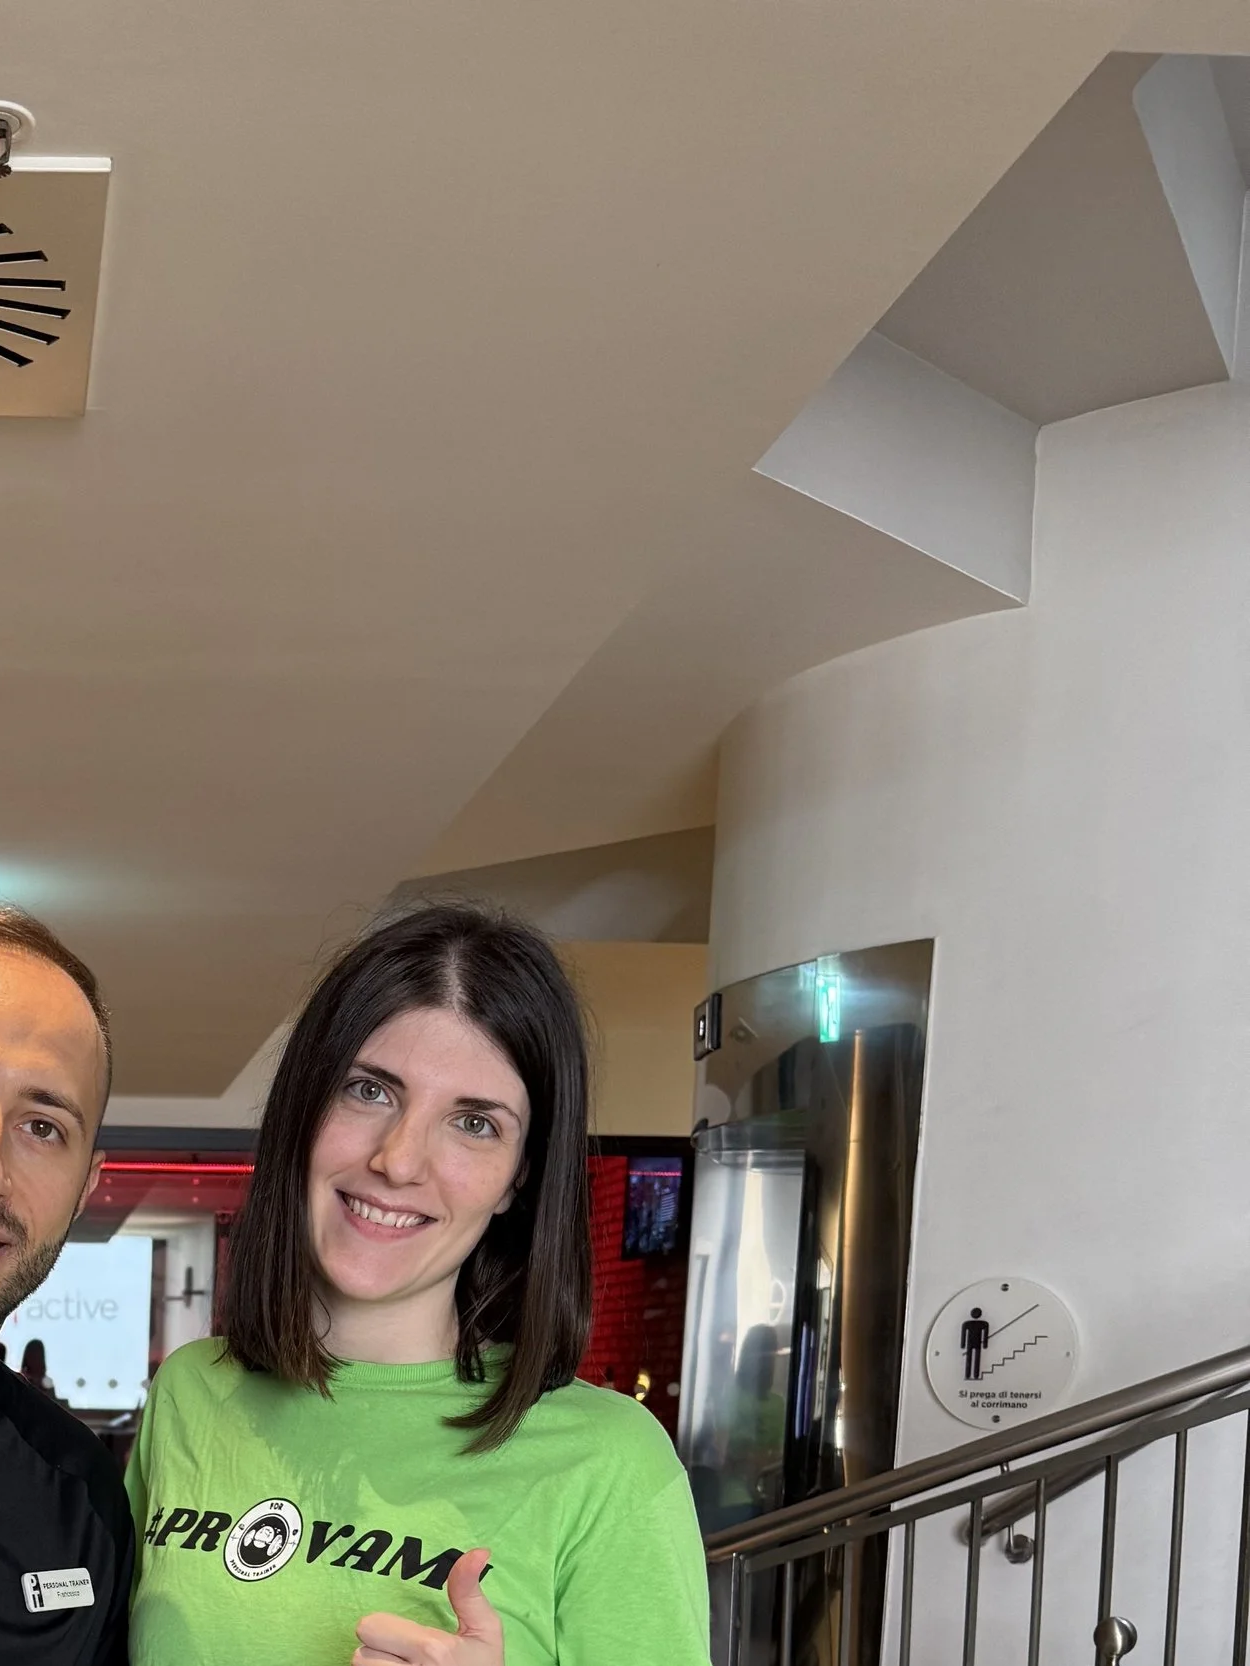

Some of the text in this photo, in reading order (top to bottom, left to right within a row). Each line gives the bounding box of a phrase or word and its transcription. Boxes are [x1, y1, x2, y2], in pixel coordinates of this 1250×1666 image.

[26, 1288, 120, 1321] active
[959, 1390, 1041, 1401] Si prega di tenersi
[970, 1400, 1028, 1409] al corrimano
[43, 1579, 89, 1589] PERSONAL TRAINER
